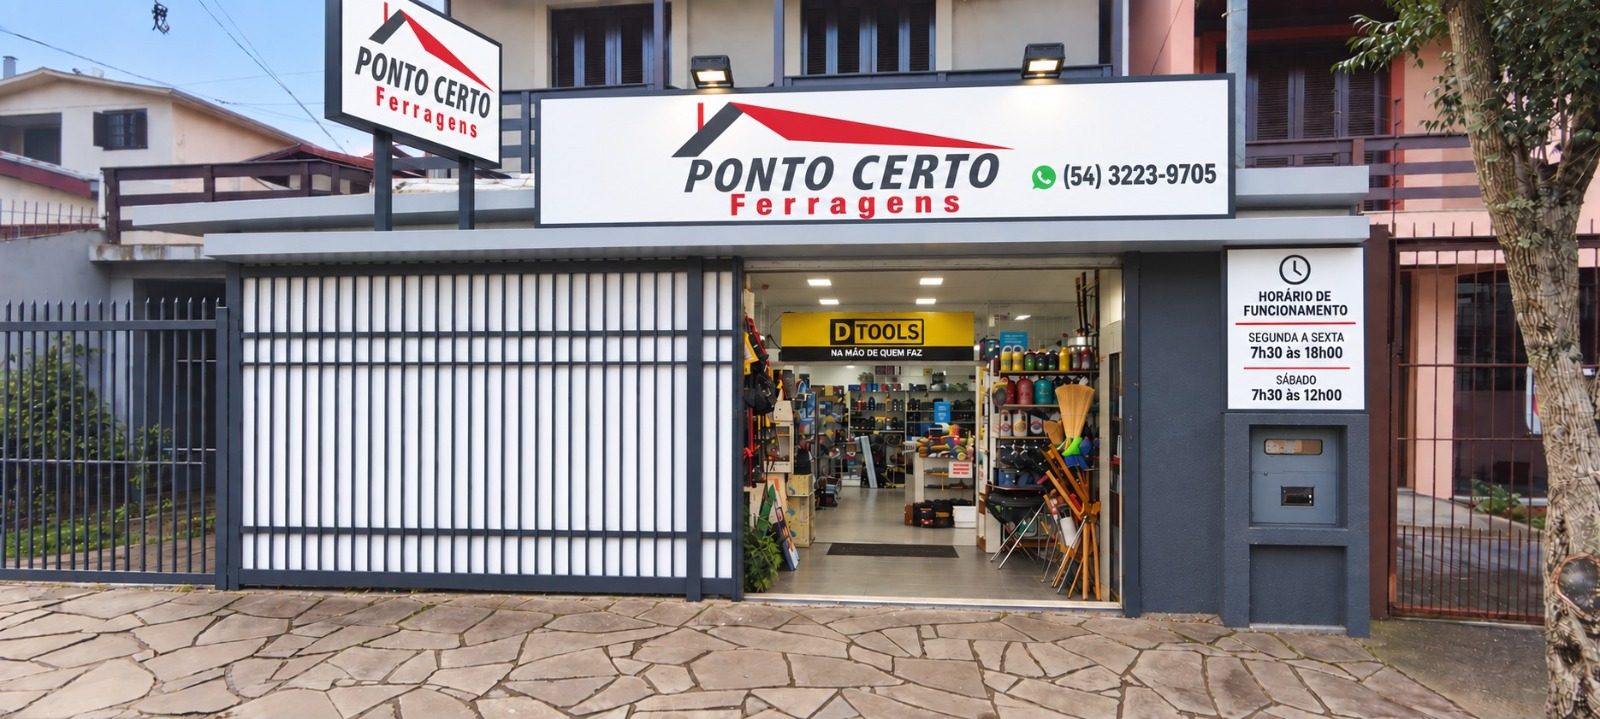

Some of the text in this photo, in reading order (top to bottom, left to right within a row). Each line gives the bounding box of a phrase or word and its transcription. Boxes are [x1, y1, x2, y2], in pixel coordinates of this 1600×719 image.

[355, 46, 491, 119] PONTO CERTO
[376, 85, 477, 139] Ferragens
[684, 153, 1000, 192] PONTO CERTO
[1063, 163, 1217, 190] (54) 3223-9705
[731, 193, 960, 219] Ferragens
[1258, 288, 1332, 302] HORÁRIO DE
[1243, 304, 1348, 317] FUNCIONAMENTO
[856, 324, 919, 340] TOOLS
[1248, 332, 1345, 343] SEGUNDA A SEXTA
[831, 349, 843, 357] NA
[867, 349, 879, 357] DE
[880, 349, 905, 358] QUEM
[907, 349, 923, 357] FAZ
[1250, 346, 1343, 359] 7h30 às 18h00
[1276, 373, 1317, 385] SÁBADO
[1251, 387, 1342, 401] 7h30 às 12h00
